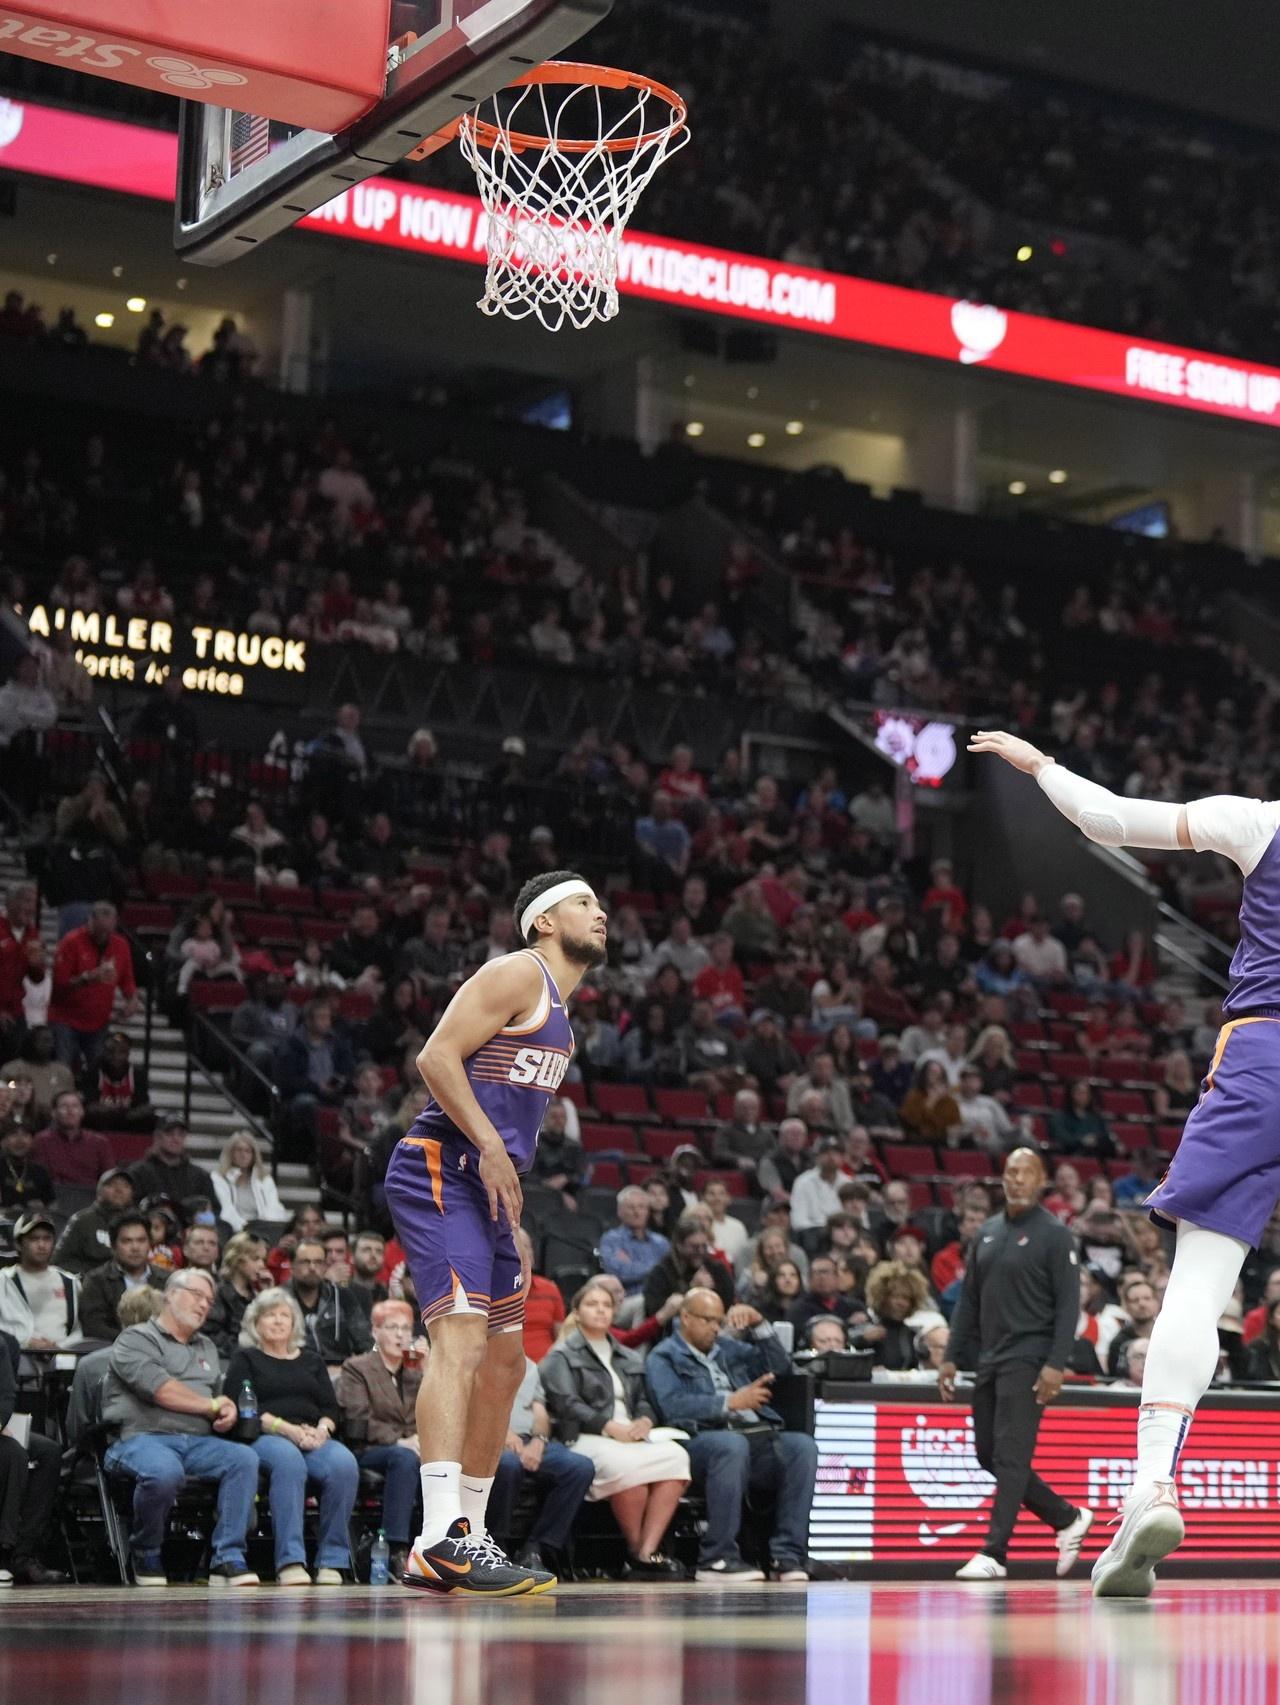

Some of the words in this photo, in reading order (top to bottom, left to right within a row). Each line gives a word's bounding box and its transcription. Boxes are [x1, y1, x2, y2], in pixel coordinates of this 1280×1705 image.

[352, 184, 397, 231] UP
[400, 194, 473, 249] NOW
[1126, 347, 1185, 396] FREE
[14, 602, 173, 654] AIMLER
[192, 626, 306, 672] TRUCK
[1181, 1459, 1269, 1509] SIGN
